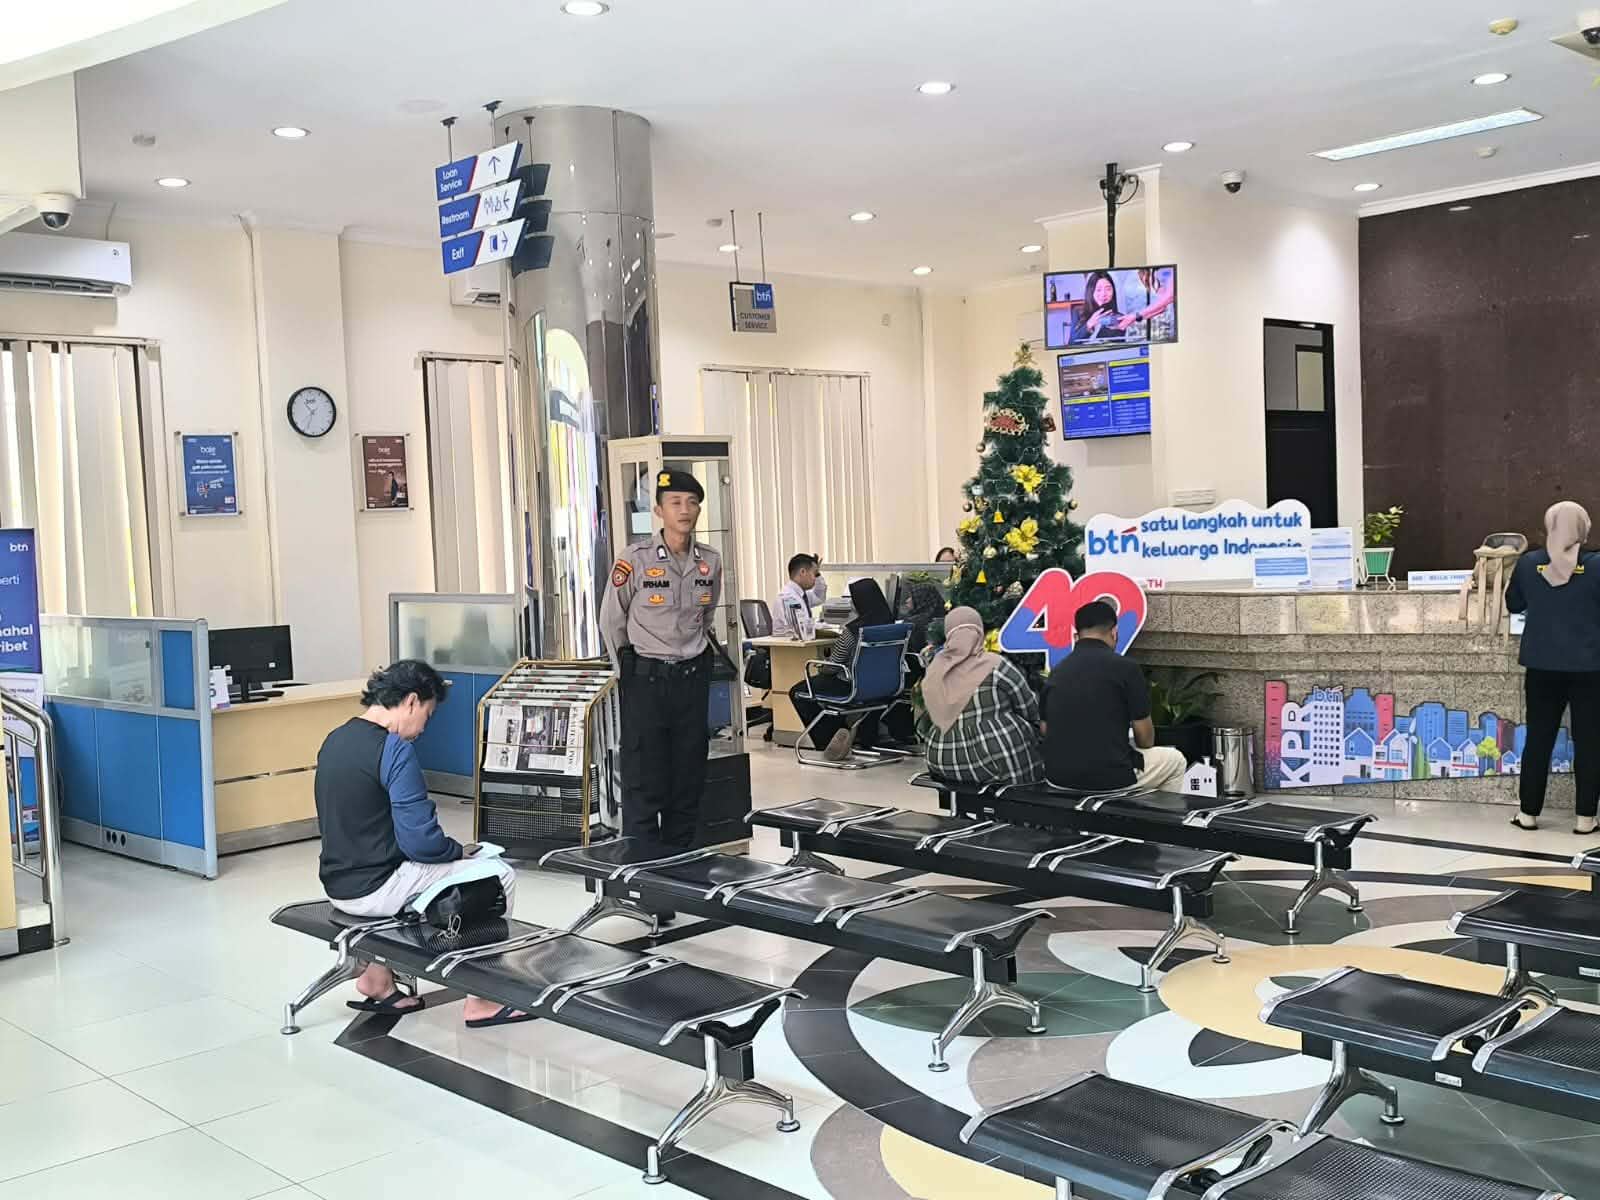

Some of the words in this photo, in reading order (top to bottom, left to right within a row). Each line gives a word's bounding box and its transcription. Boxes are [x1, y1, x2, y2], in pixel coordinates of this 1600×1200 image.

[442, 168, 458, 180] Loan
[440, 179, 462, 192] Service
[441, 211, 470, 224] Restroom
[452, 247, 464, 260] Exit
[756, 289, 771, 302] btn
[1141, 516, 1178, 533] satu
[1182, 513, 1248, 533] langkah
[1252, 511, 1303, 529] untuk
[9, 543, 29, 552] btn
[1088, 526, 1140, 556] btn
[1142, 540, 1219, 560] keluarga
[1147, 579, 1163, 589] TH
[1313, 685, 1343, 703] btn
[1279, 701, 1313, 788] KPR
